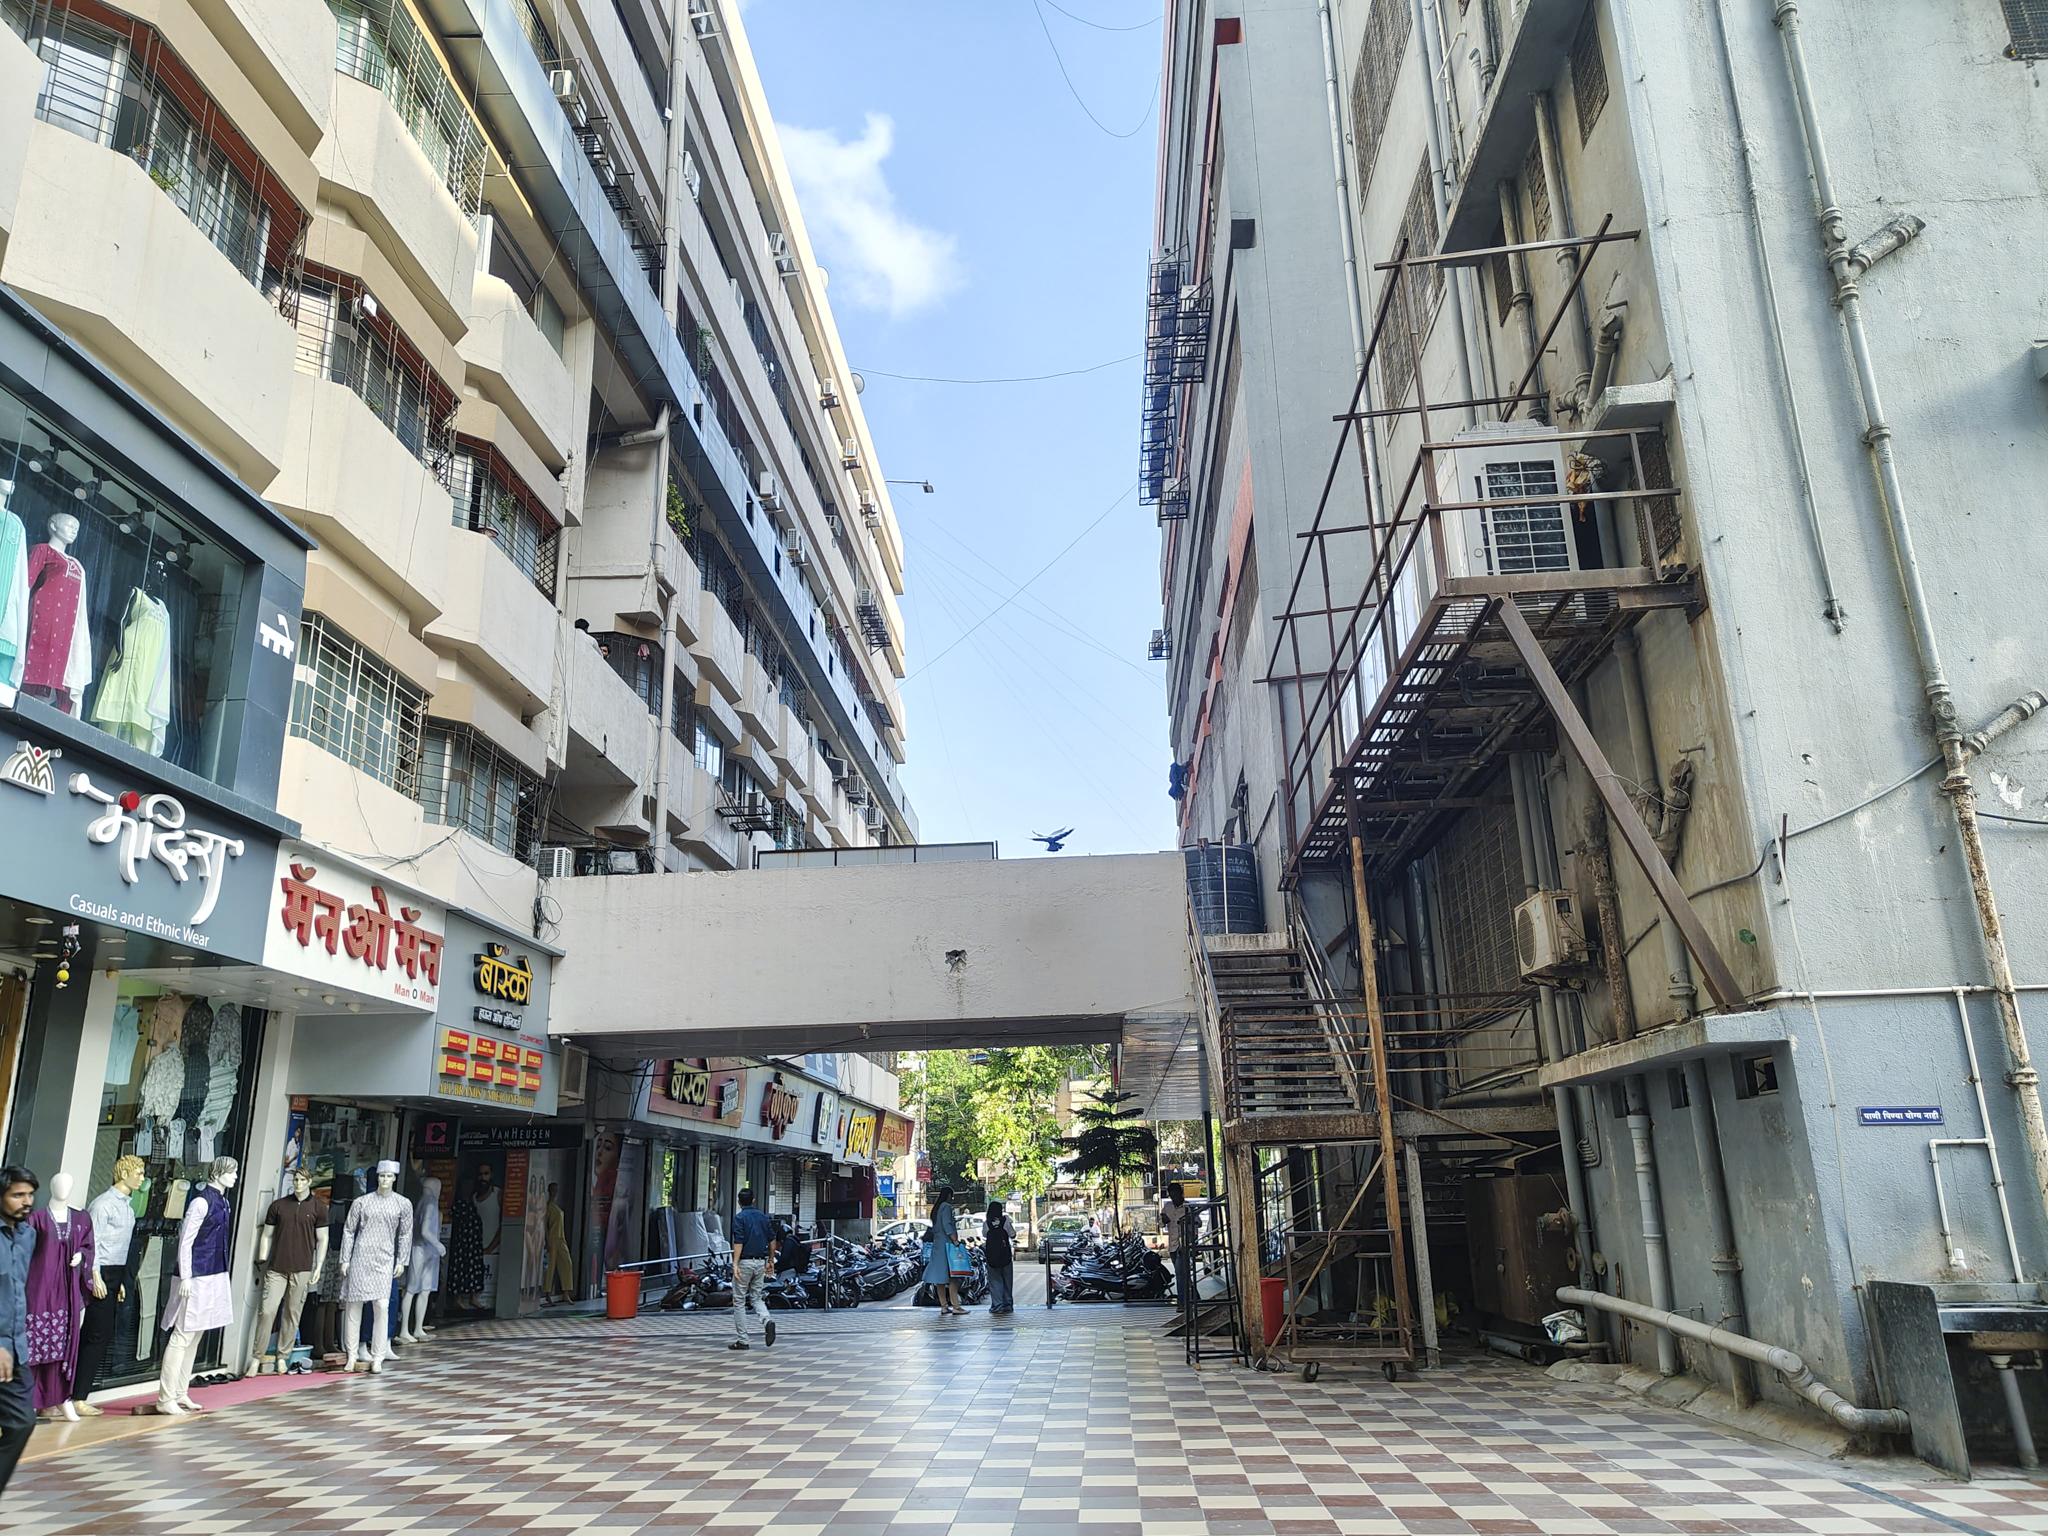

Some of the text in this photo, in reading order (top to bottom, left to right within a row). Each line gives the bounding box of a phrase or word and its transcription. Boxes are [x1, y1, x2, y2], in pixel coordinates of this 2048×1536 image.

[69, 773, 244, 925] मंदिरा
[70, 893, 210, 948] Casuals and Ethnic Wear
[281, 863, 444, 986] मॅन ओ मॅन
[394, 983, 435, 1005] Man O Man
[475, 943, 533, 1006] बॉस्को
[438, 1082, 453, 1095] ALL
[453, 1083, 482, 1099] BRANDS
